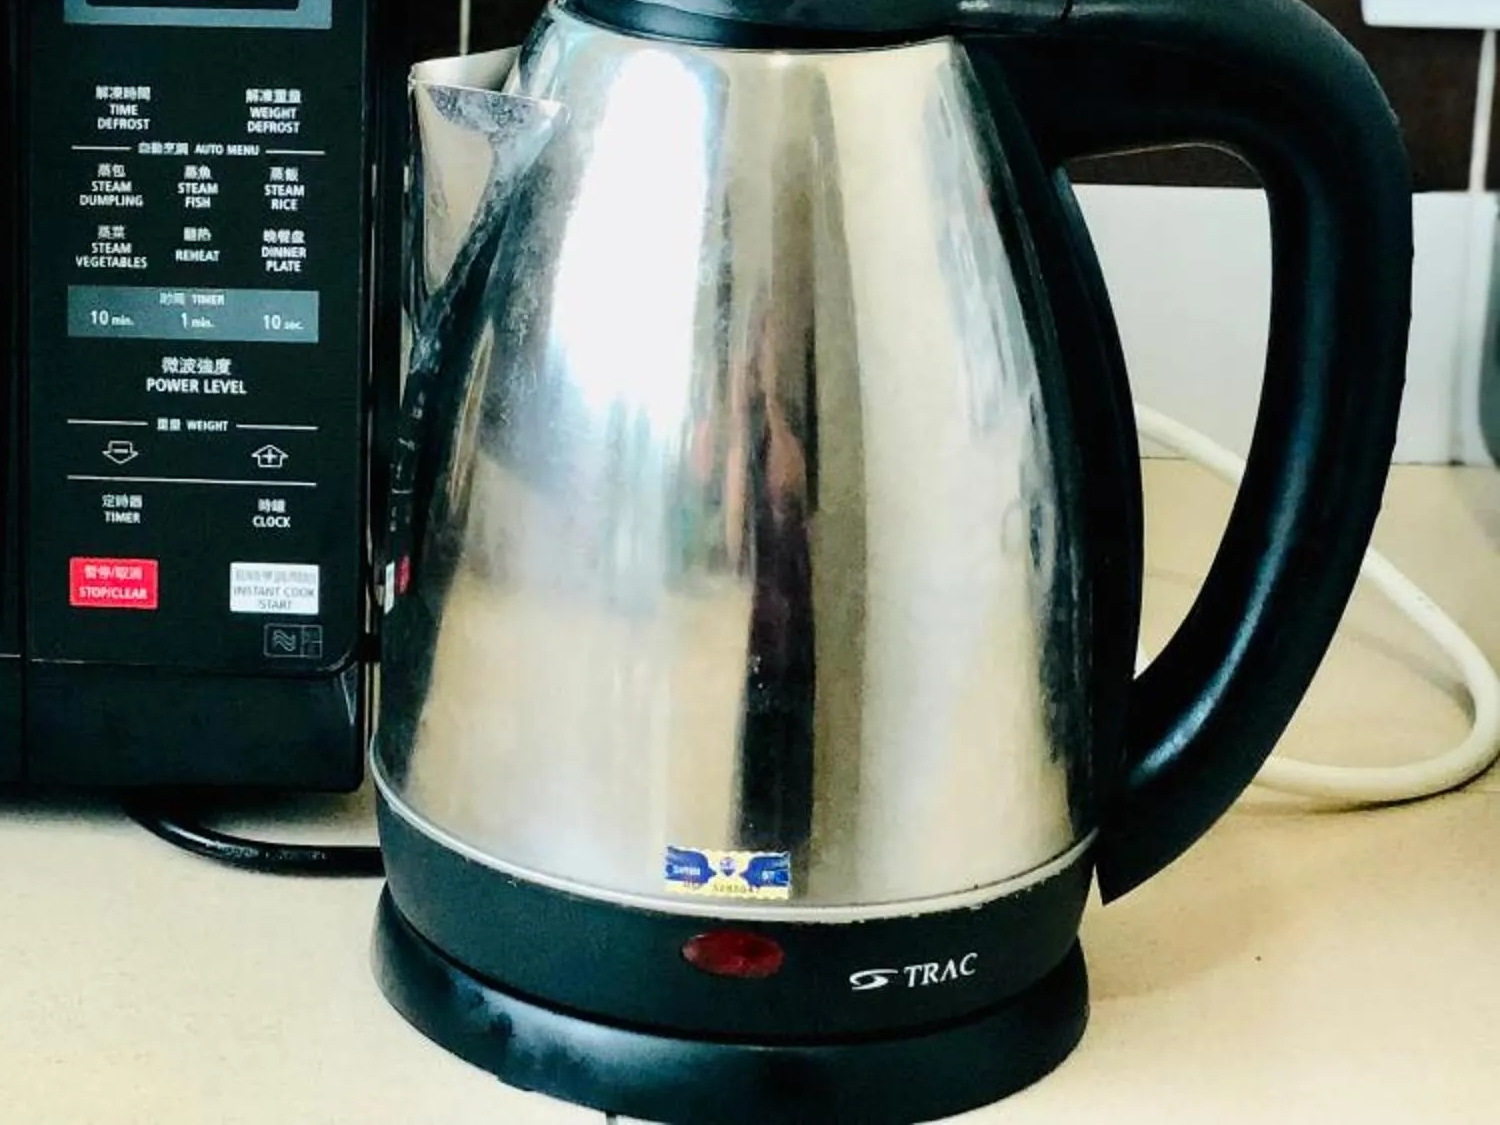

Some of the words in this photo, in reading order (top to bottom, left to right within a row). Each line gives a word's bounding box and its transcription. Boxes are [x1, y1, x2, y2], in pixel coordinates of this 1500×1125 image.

[109, 103, 139, 117] TIME
[249, 106, 298, 120] WEIGHT
[97, 118, 151, 131] DEFROST
[247, 120, 301, 135] DEFROST
[193, 144, 225, 156] AUTO
[225, 145, 261, 157] MENU
[91, 180, 132, 193] STEAM
[177, 182, 219, 195] STEAM
[264, 184, 306, 197] STEAM
[79, 194, 144, 207] DUMPLING
[184, 196, 212, 209] FISH
[271, 198, 299, 211] RICE
[91, 242, 132, 255] STEAM
[261, 246, 307, 260] DINNER
[75, 255, 148, 270] VEGETABLES
[175, 249, 220, 263] REHEAT
[265, 259, 303, 273] PLATE
[191, 294, 225, 306] TIMER
[90, 310, 109, 326] 10
[180, 311, 188, 328] 1
[263, 314, 282, 330] 10
[161, 356, 232, 375] 微波強度
[146, 377, 199, 393] POWER
[203, 378, 248, 395] LEVEL
[186, 419, 229, 432] WEIGHT
[104, 510, 142, 525] TIMER
[252, 515, 292, 528] CLOCK
[78, 585, 148, 600] STOP/CLEAR
[233, 585, 282, 598] INSTANT
[283, 585, 316, 598] COOK
[258, 599, 293, 610] START
